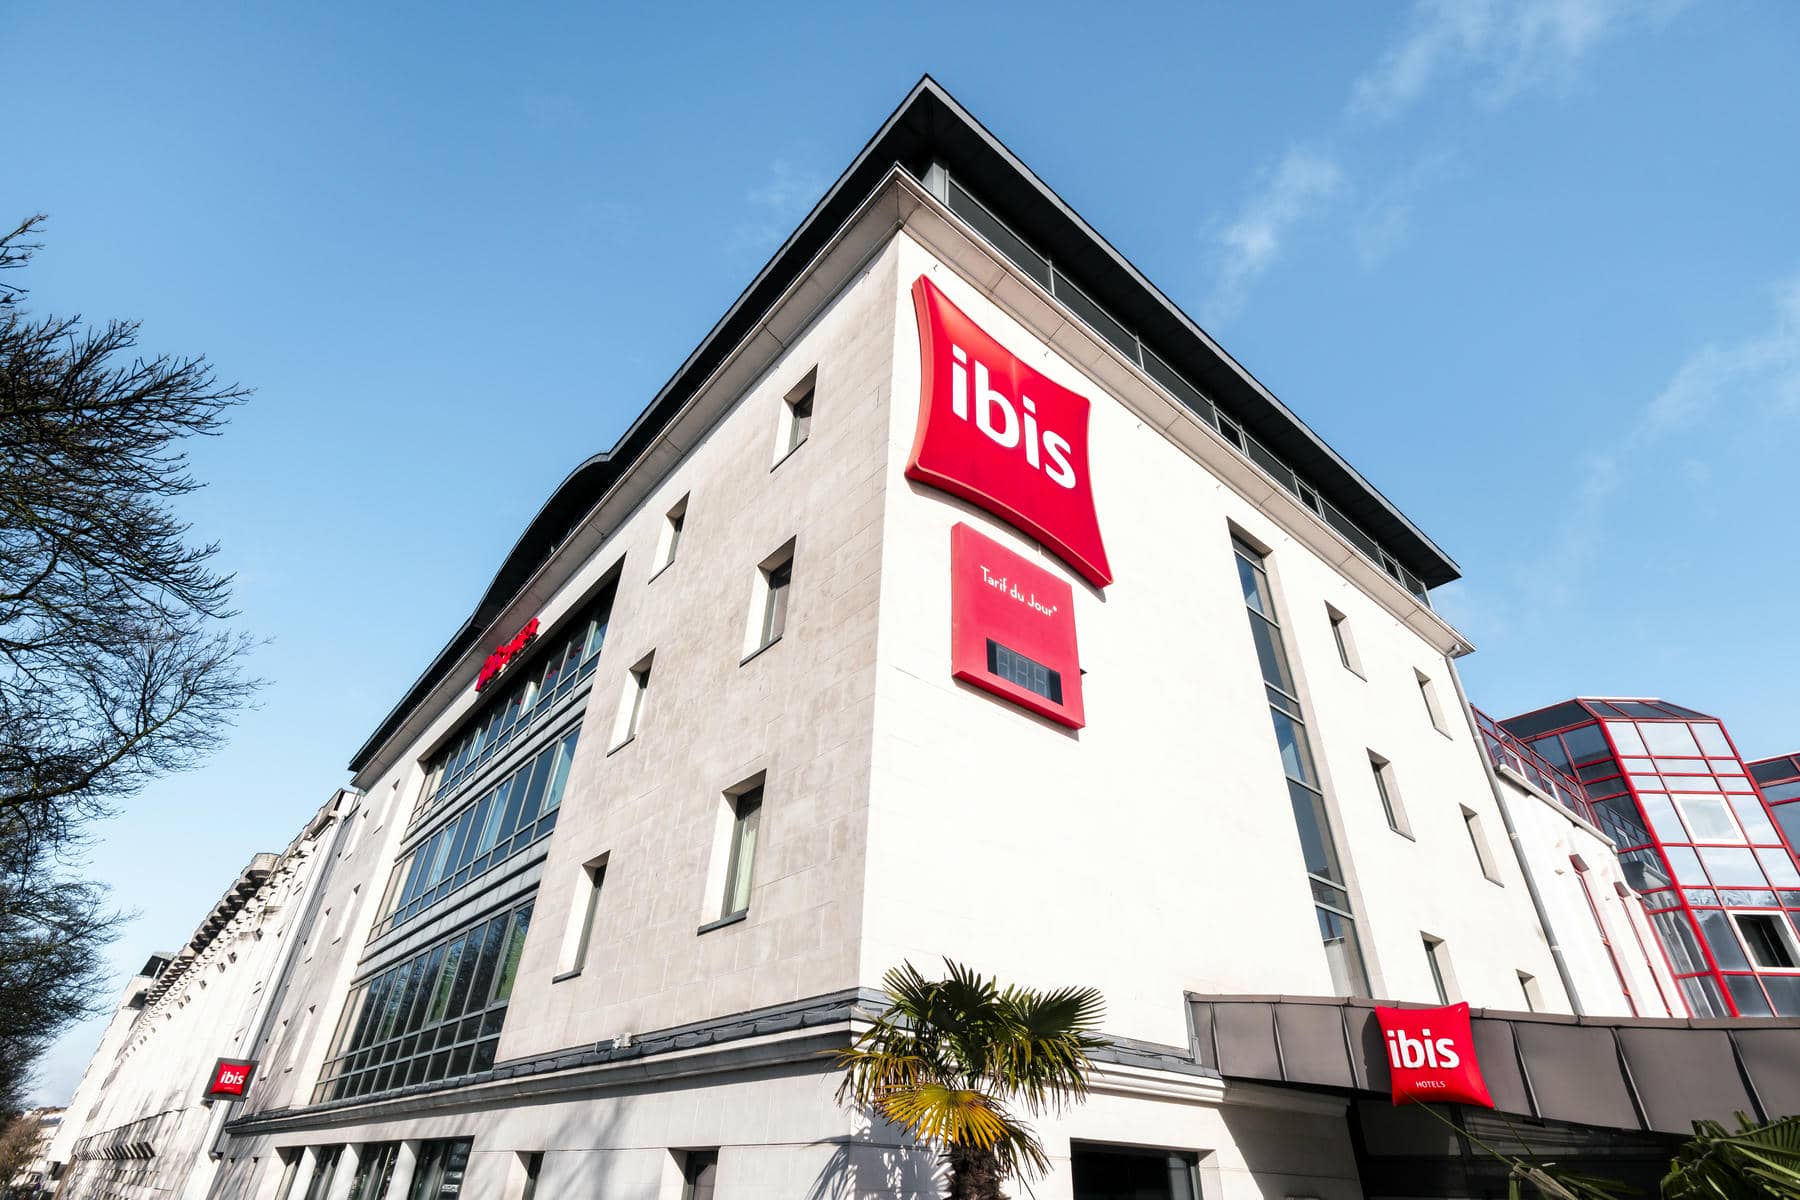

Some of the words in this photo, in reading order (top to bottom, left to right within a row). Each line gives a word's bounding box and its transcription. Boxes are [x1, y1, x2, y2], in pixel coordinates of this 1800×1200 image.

[952, 343, 1077, 489] ibis
[980, 565, 1007, 593] Tarif
[1009, 583, 1025, 603] du
[1386, 1028, 1460, 1069] ibis
[220, 1070, 245, 1085] ibis
[1415, 1080, 1447, 1088] HOTELS
